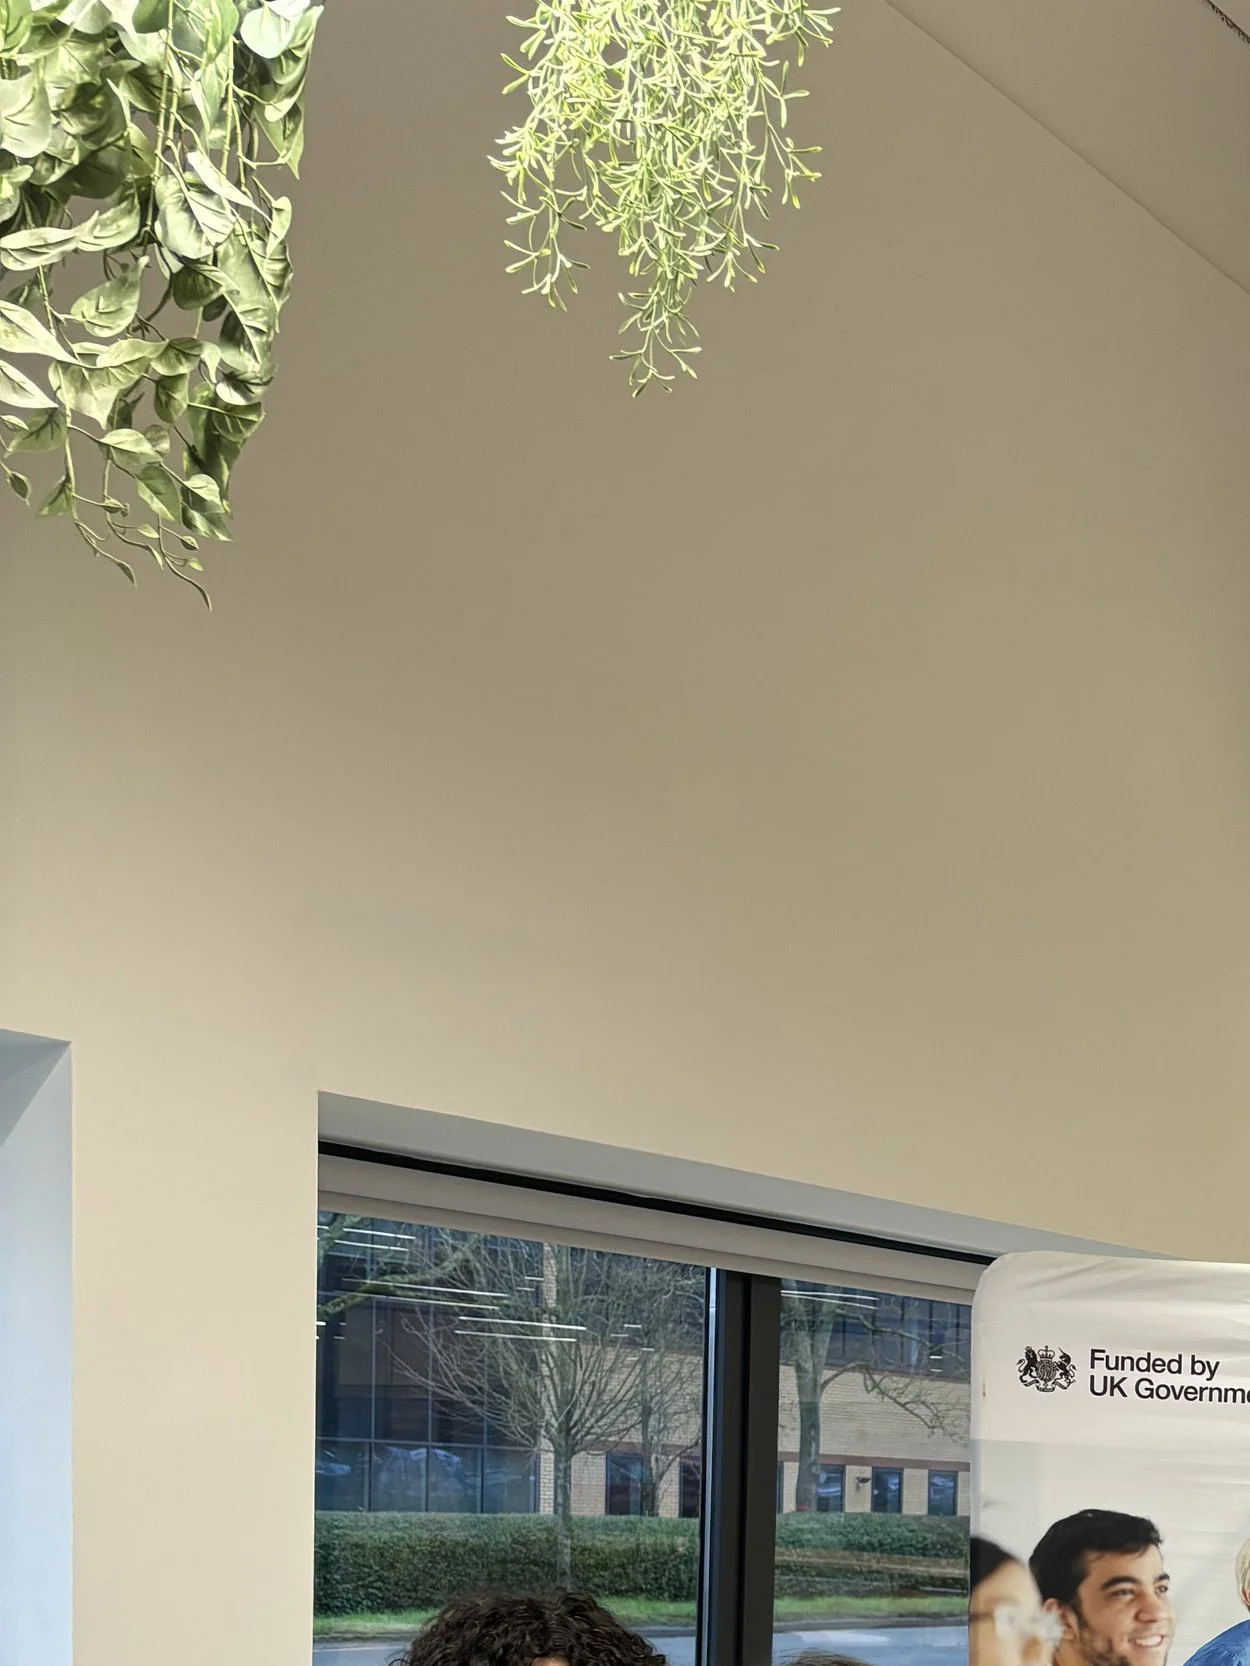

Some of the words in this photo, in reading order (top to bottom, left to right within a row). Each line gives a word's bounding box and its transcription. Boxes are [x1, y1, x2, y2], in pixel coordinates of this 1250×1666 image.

[1090, 1348, 1182, 1374] Funded
[1191, 1354, 1220, 1381] by
[1089, 1374, 1128, 1397] UK
